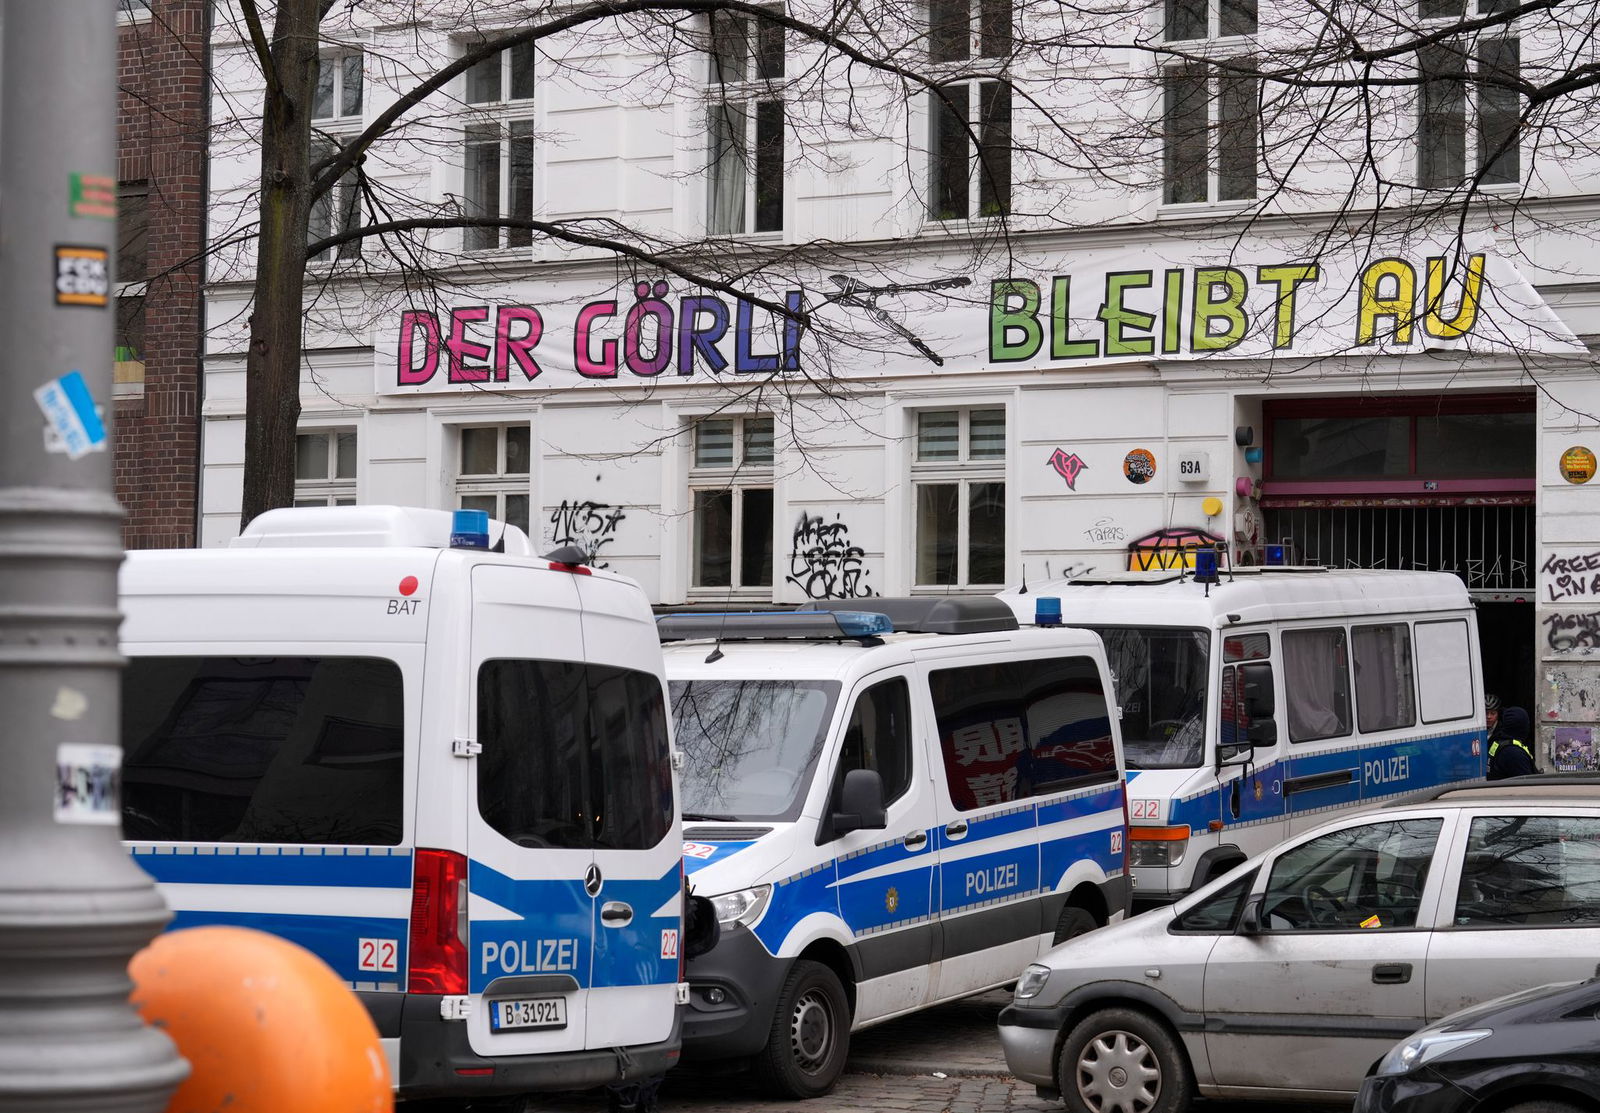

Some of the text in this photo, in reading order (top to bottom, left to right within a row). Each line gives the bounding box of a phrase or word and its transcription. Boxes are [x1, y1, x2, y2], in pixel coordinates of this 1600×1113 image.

[397, 253, 1486, 386] DER GÖRLI BLEIBT AU
[1181, 461, 1200, 474] 63A
[387, 600, 421, 615] BAT
[1365, 755, 1409, 785] POLIZEI
[1134, 802, 1158, 817] 22
[1111, 833, 1122, 853] 22
[966, 863, 1018, 896] POLIZEI
[362, 942, 394, 968] 22
[482, 939, 578, 974] POLIZEI
[662, 932, 677, 957] 22
[523, 1002, 559, 1023] 31921
